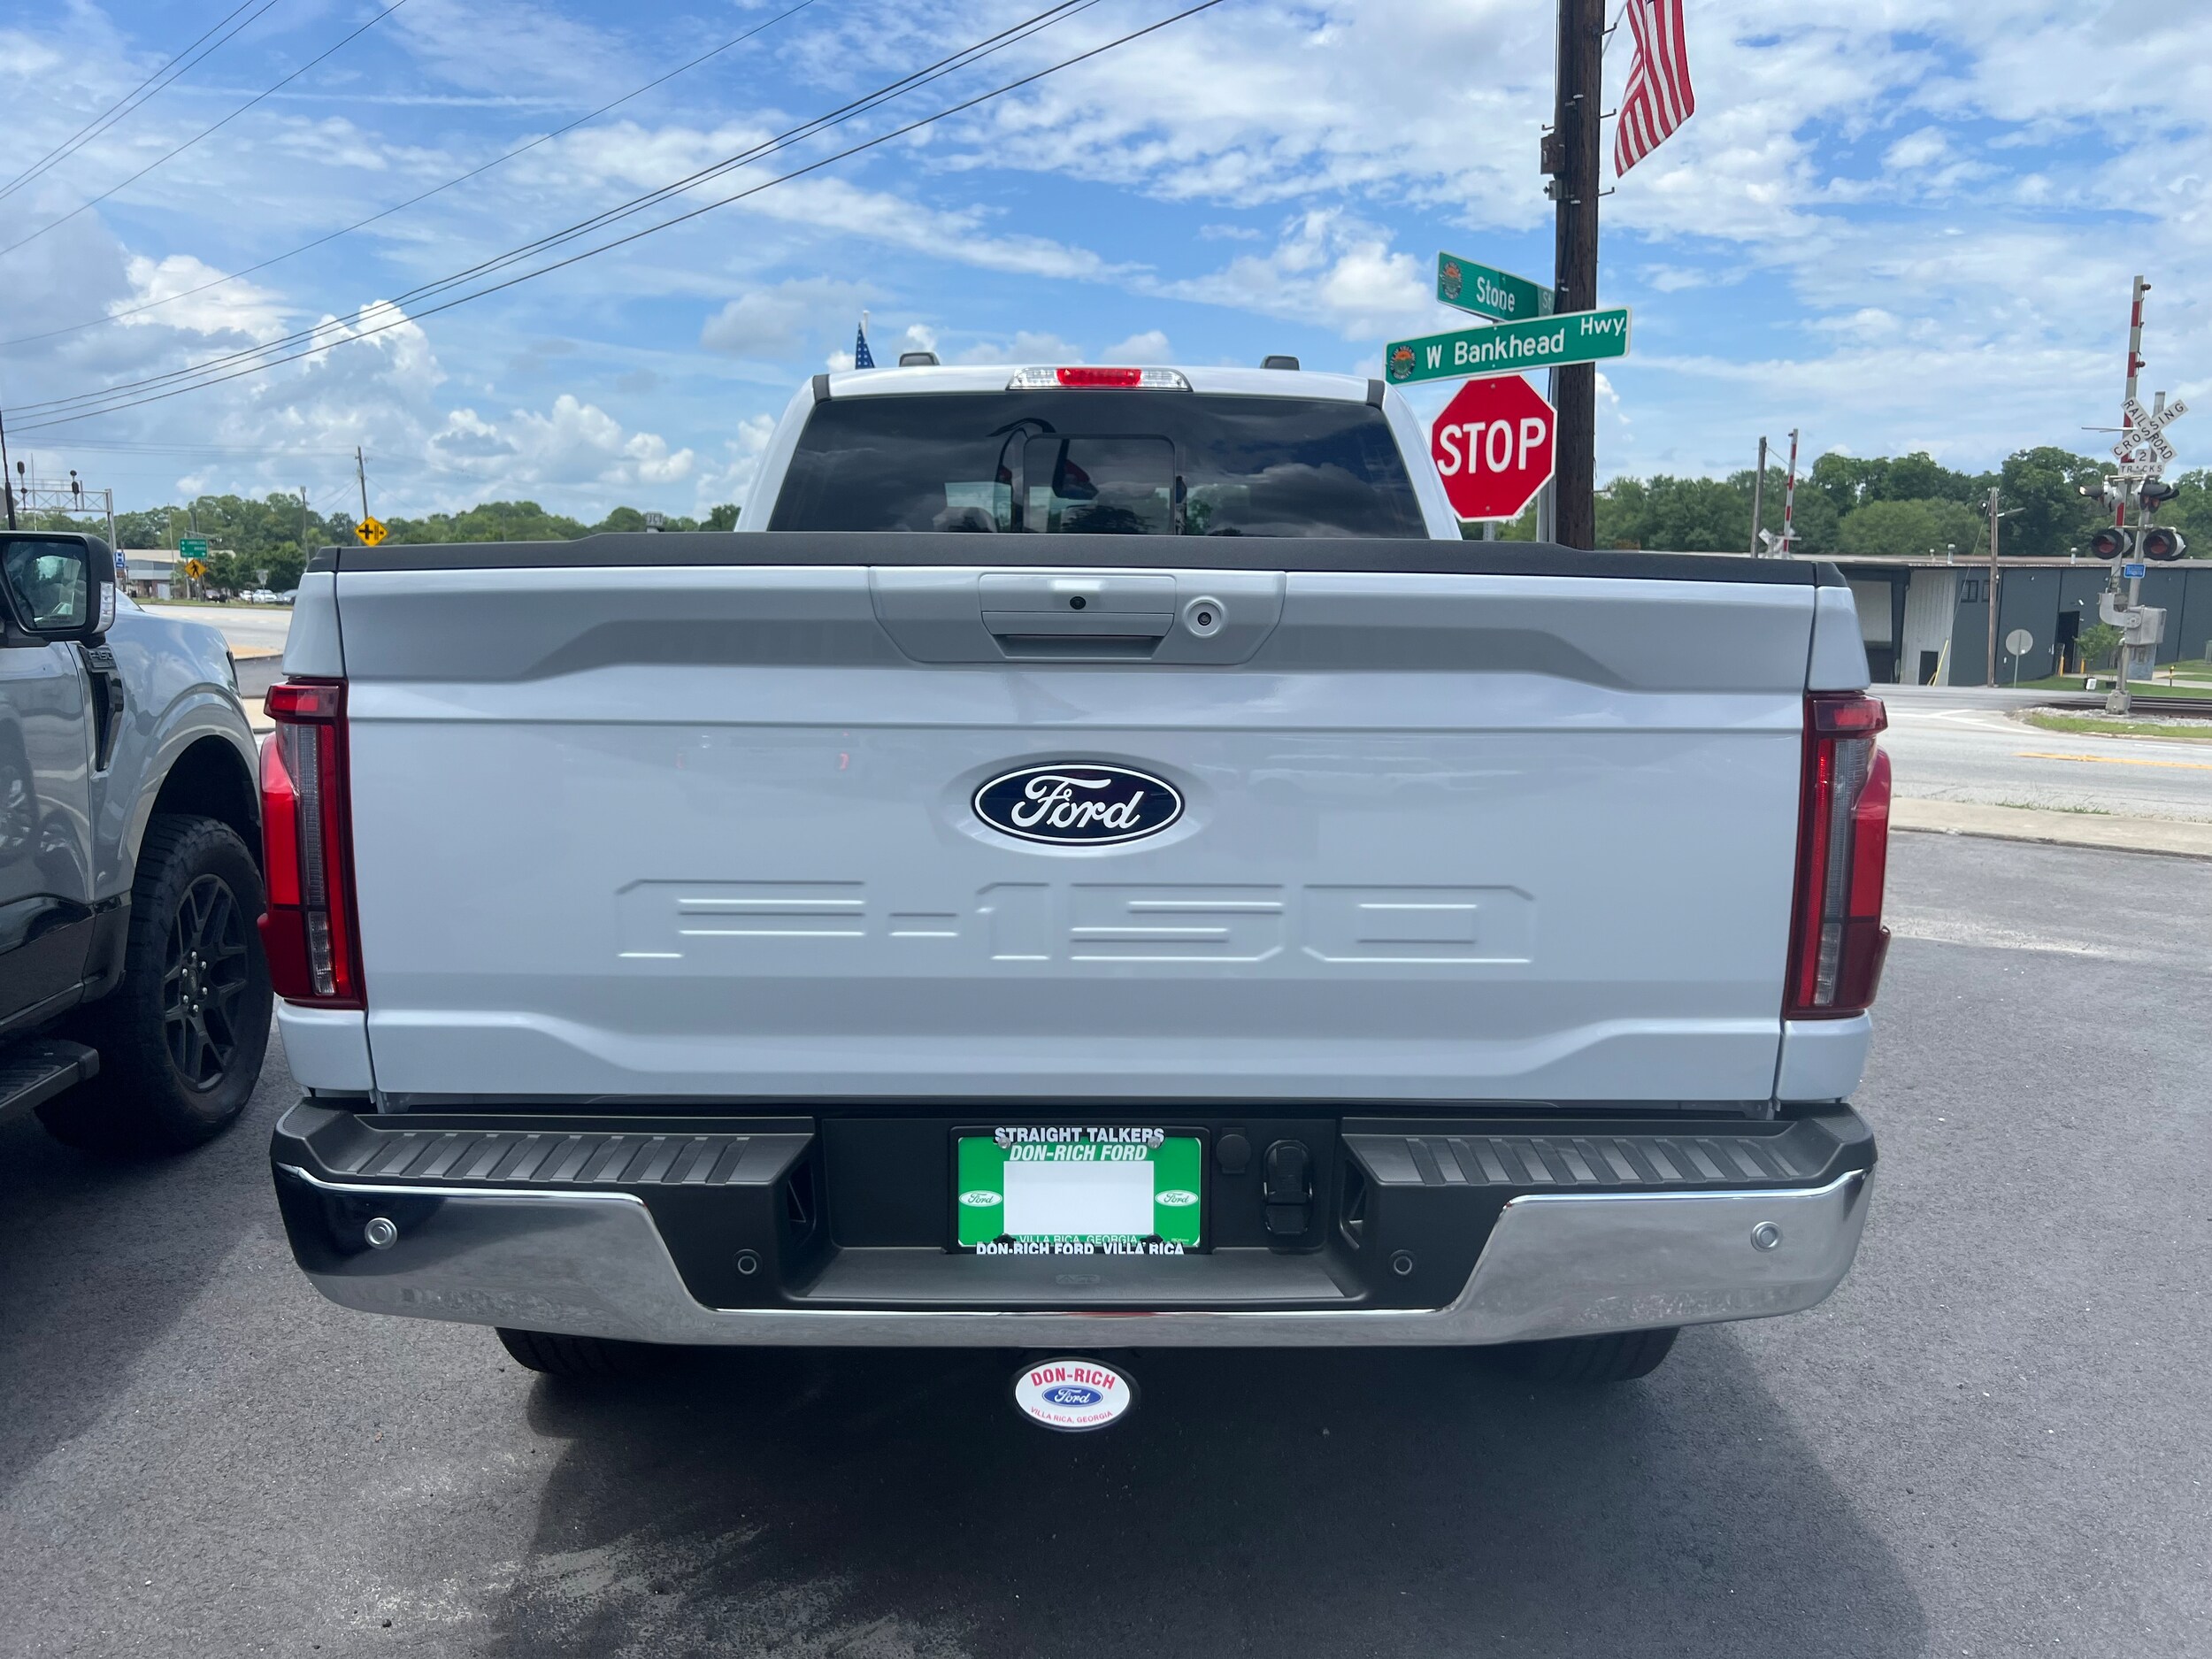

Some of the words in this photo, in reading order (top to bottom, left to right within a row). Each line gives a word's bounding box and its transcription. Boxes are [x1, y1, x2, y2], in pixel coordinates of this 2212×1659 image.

[1477, 276, 1515, 311] Stone
[1541, 290, 1552, 311] St
[1426, 344, 1443, 370] W
[1454, 327, 1564, 365] Bankhead
[1580, 316, 1624, 336] Hwy
[1437, 417, 1547, 476] STOP
[2139, 451, 2147, 461] 2
[2121, 465, 2162, 473] TRCKS
[1011, 775, 1145, 829] Ford
[616, 879, 1536, 966] F-150
[995, 1127, 1081, 1143] STRAIGHT
[1087, 1128, 1164, 1143] TALKERS
[1009, 1144, 1095, 1161] DON-RICH
[1100, 1144, 1148, 1161] FORD
[967, 1193, 994, 1203] Ford
[1164, 1192, 1190, 1203] Ford
[1054, 1242, 1094, 1255] FORD
[1102, 1242, 1144, 1255] VILLA
[1149, 1242, 1185, 1255] RICA
[1031, 1367, 1116, 1389] DON-RICH
[1054, 1388, 1090, 1403] Ford
[1031, 1407, 1052, 1420] VILLA
[1076, 1410, 1113, 1424] GEORGIA
